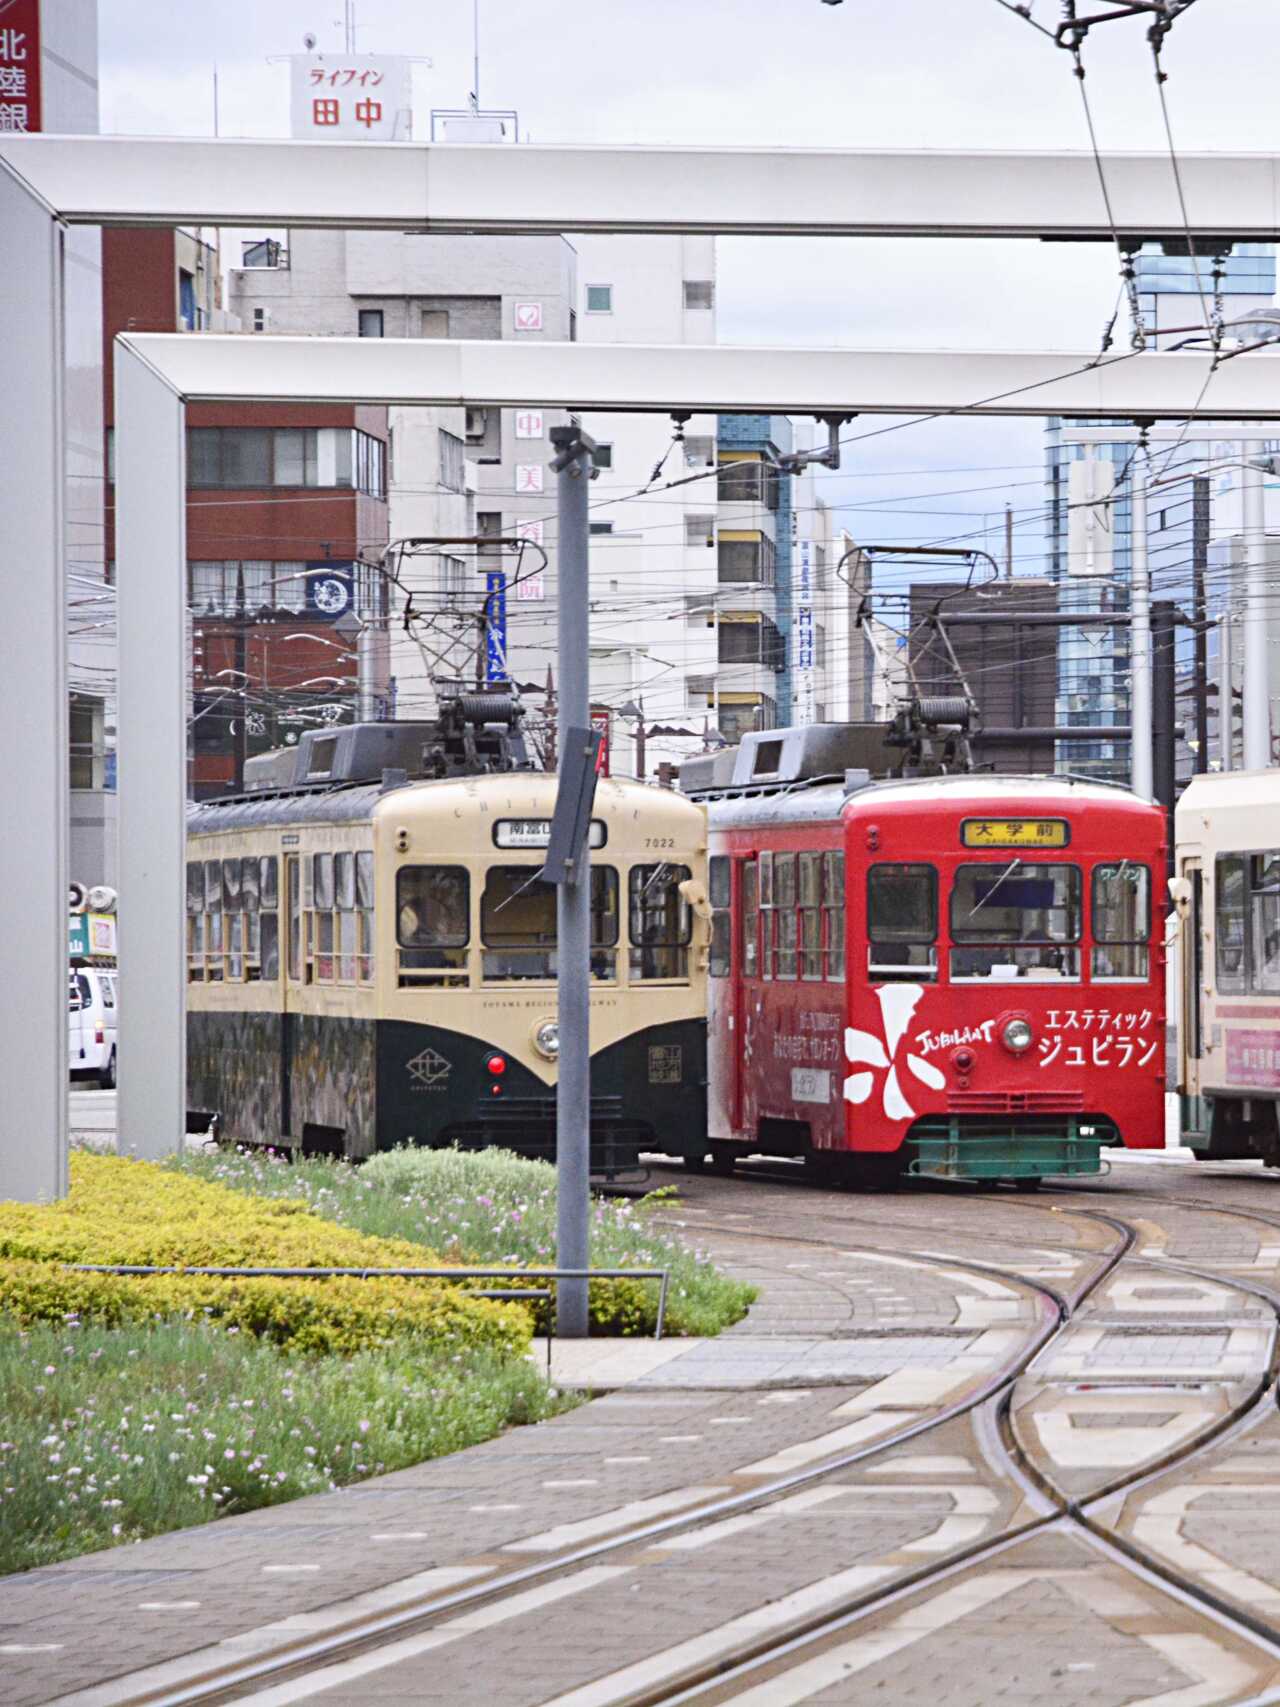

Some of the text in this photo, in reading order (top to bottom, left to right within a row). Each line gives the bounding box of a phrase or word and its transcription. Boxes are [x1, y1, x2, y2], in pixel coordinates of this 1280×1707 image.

[309, 68, 385, 87] ライフイン
[313, 97, 382, 128] 田中
[976, 823, 1054, 837] 大学前
[644, 838, 675, 848] 7022
[1045, 1009, 1153, 1030] エステティック
[915, 1020, 997, 1055] JUBILANT
[1038, 1035, 1157, 1067] ジュビラン
